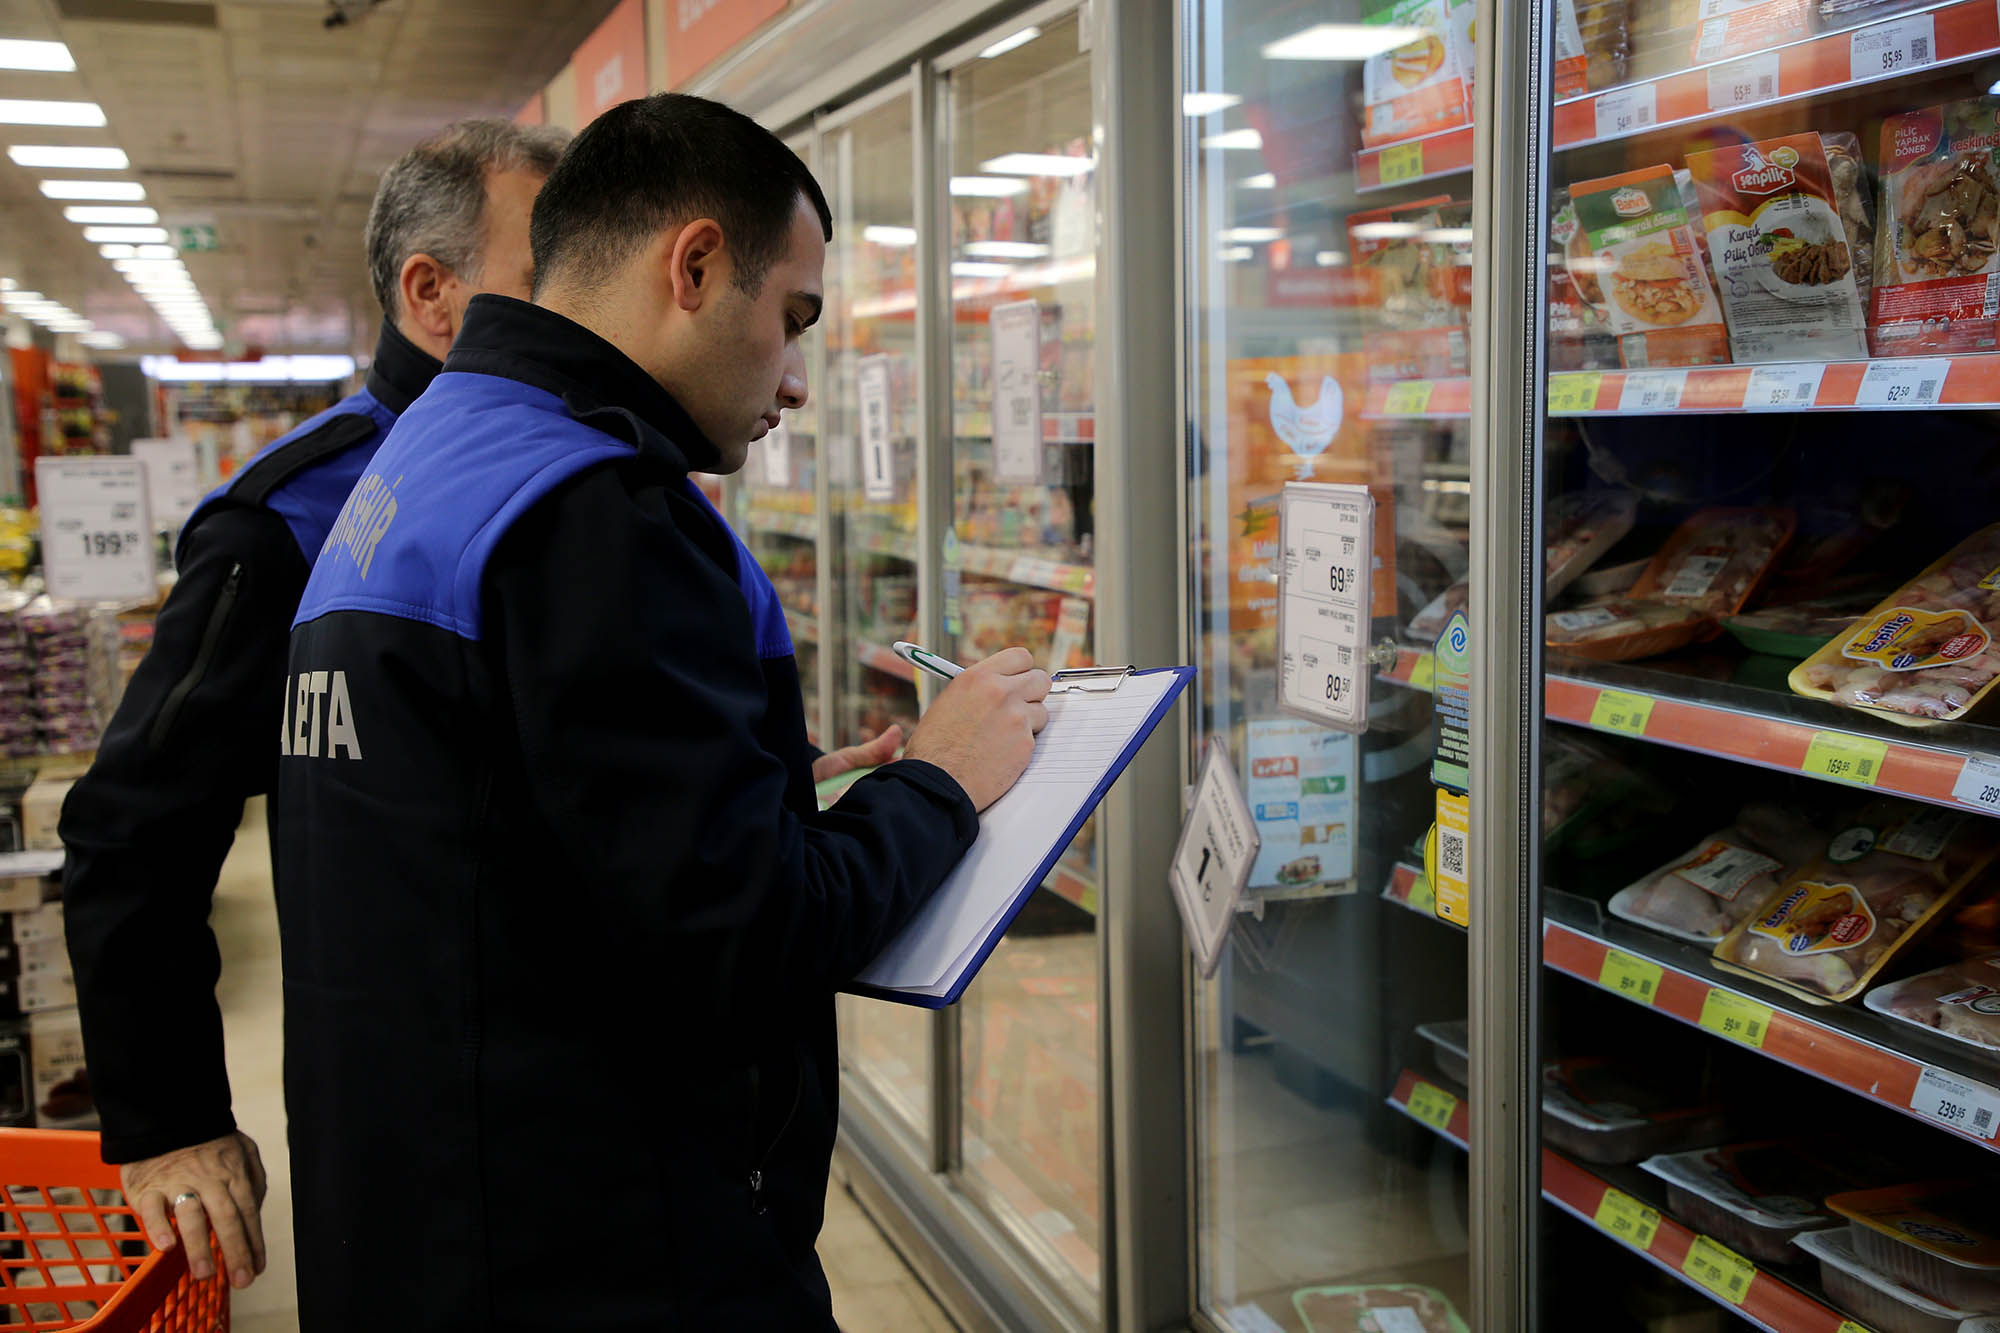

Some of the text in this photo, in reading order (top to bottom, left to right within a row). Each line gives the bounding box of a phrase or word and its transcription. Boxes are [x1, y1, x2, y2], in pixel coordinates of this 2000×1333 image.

[1895, 126, 1917, 138] PİLİÇ
[1895, 134, 1930, 148] YAPRAK
[1895, 143, 1926, 157] DÖNER
[1739, 167, 1787, 190] şenpiliç
[1728, 224, 1761, 244] Karışık
[1724, 246, 1747, 264] Piliç
